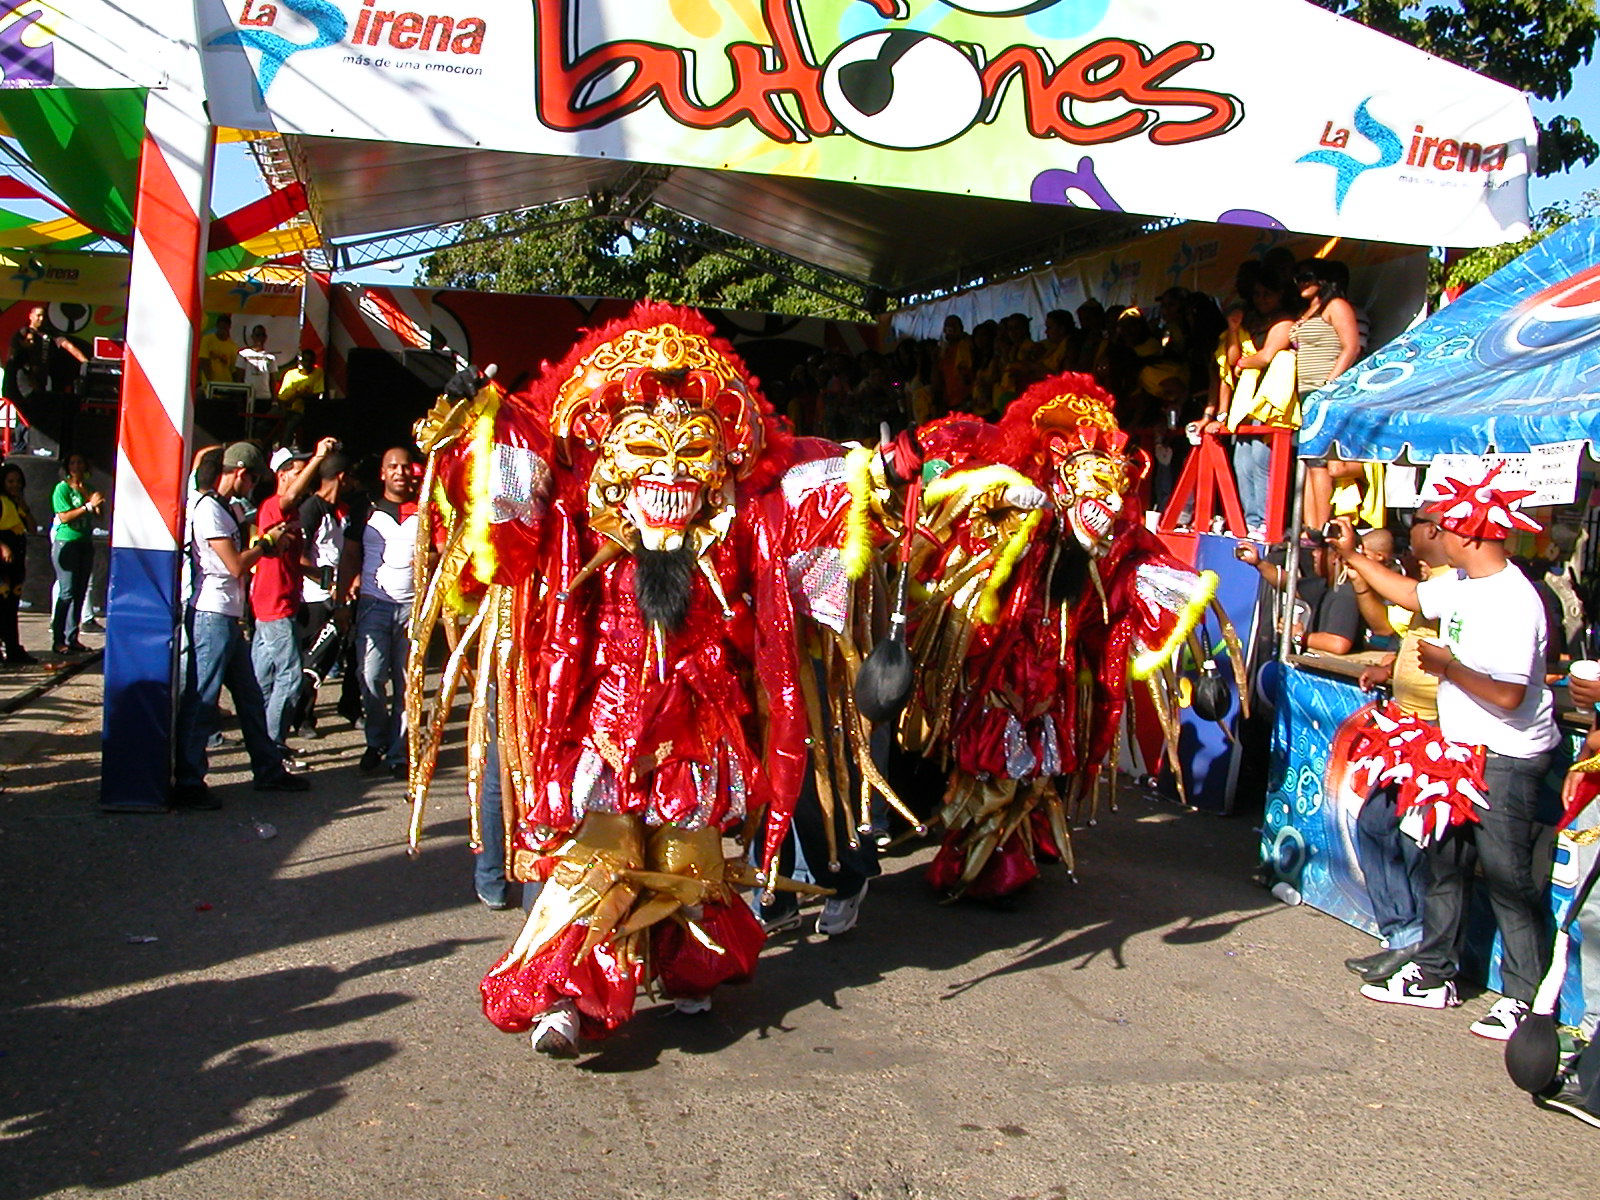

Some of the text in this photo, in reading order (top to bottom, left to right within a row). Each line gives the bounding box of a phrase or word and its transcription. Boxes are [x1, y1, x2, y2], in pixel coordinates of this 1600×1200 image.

[239, 0, 278, 27] La
[342, 54, 371, 67] más
[374, 57, 391, 68] de
[395, 61, 420, 71] una
[1319, 96, 1508, 180] La Sirena
